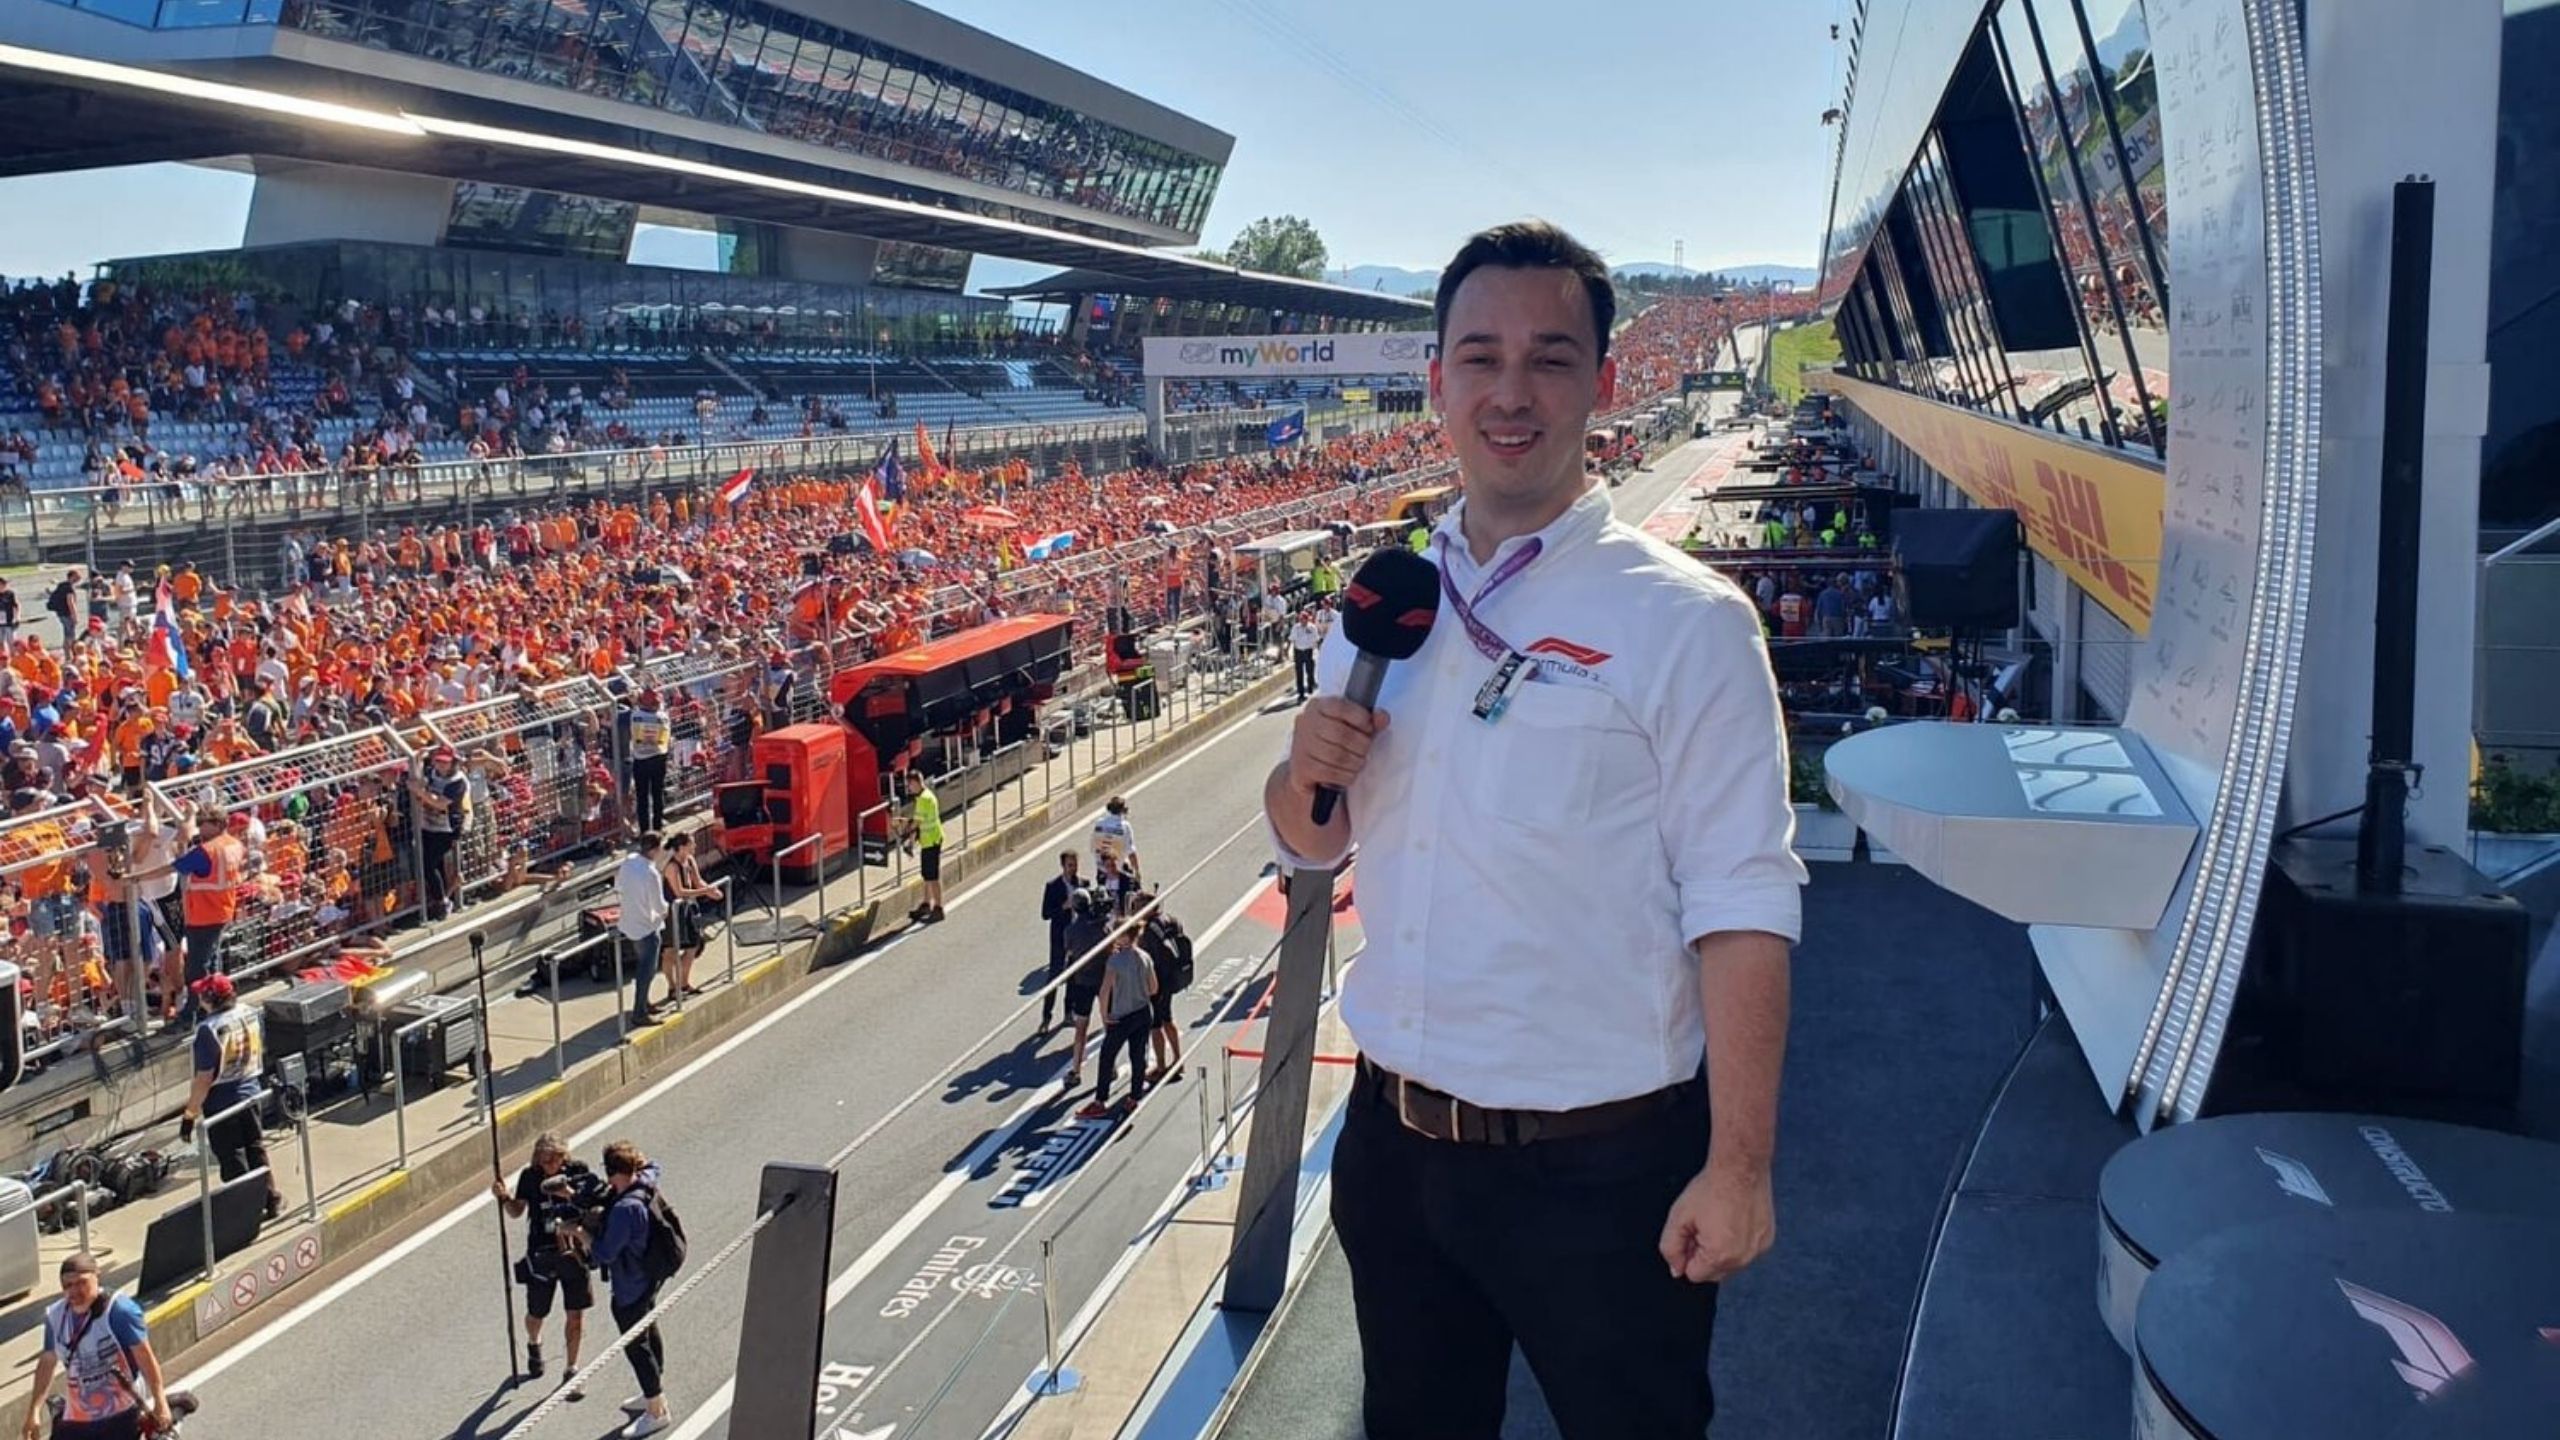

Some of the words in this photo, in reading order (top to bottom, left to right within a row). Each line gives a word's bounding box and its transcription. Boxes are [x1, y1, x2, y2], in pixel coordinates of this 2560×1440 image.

[1220, 340, 1335, 367] myWorld
[2033, 458, 2133, 603] DHL
[2356, 1124, 2454, 1213] CONSTRUCTO
[879, 1235, 988, 1319] Emirates
